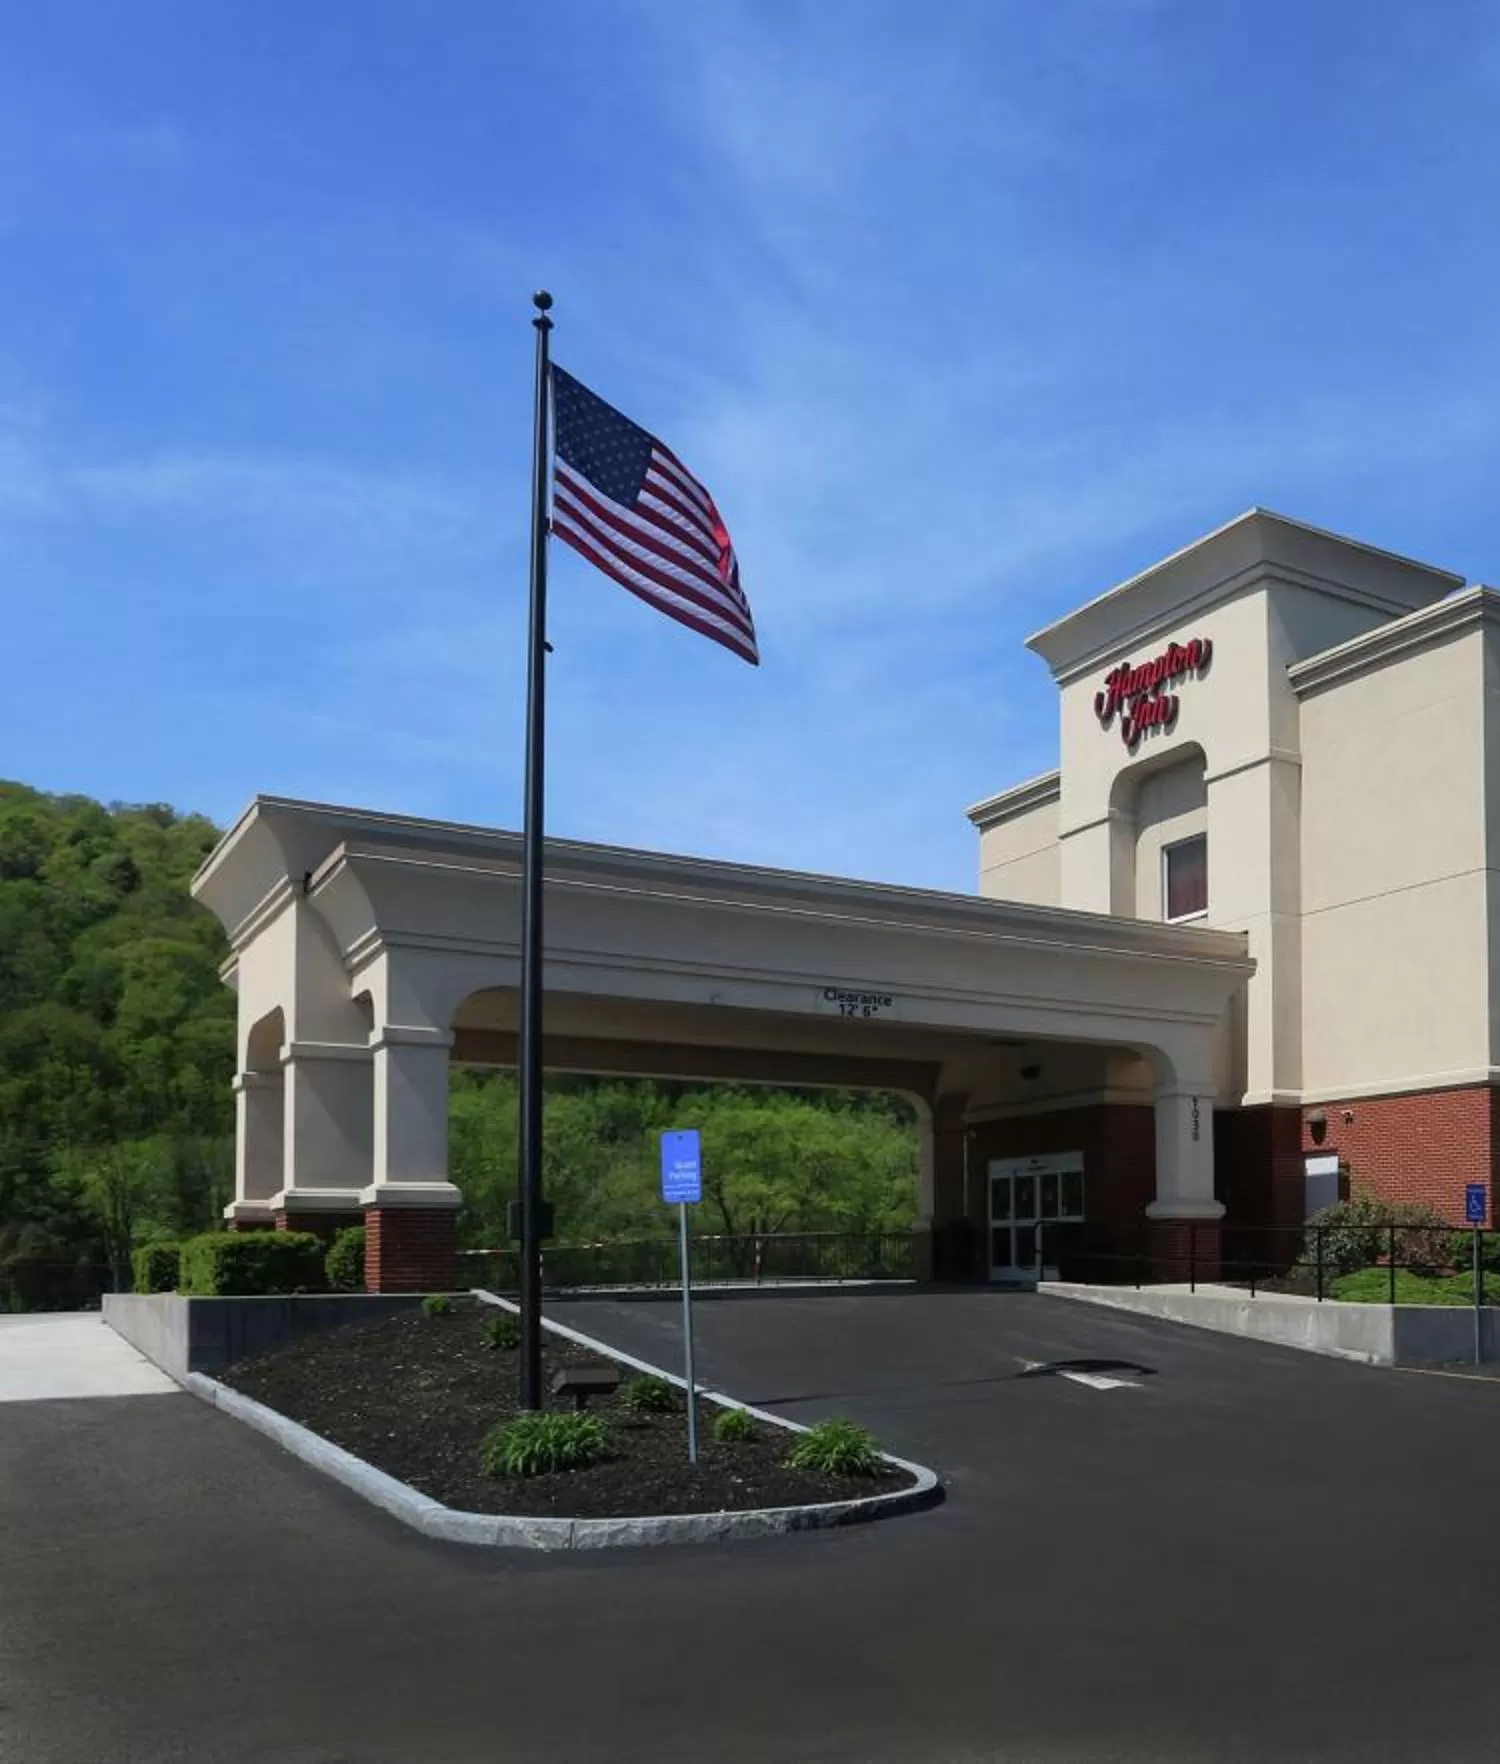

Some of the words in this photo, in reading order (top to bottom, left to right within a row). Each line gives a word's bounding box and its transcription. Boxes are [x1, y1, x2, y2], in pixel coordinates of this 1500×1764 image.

[1094, 637, 1213, 722] Hampton
[1121, 693, 1180, 750] Inn
[823, 987, 893, 1008] Clearance
